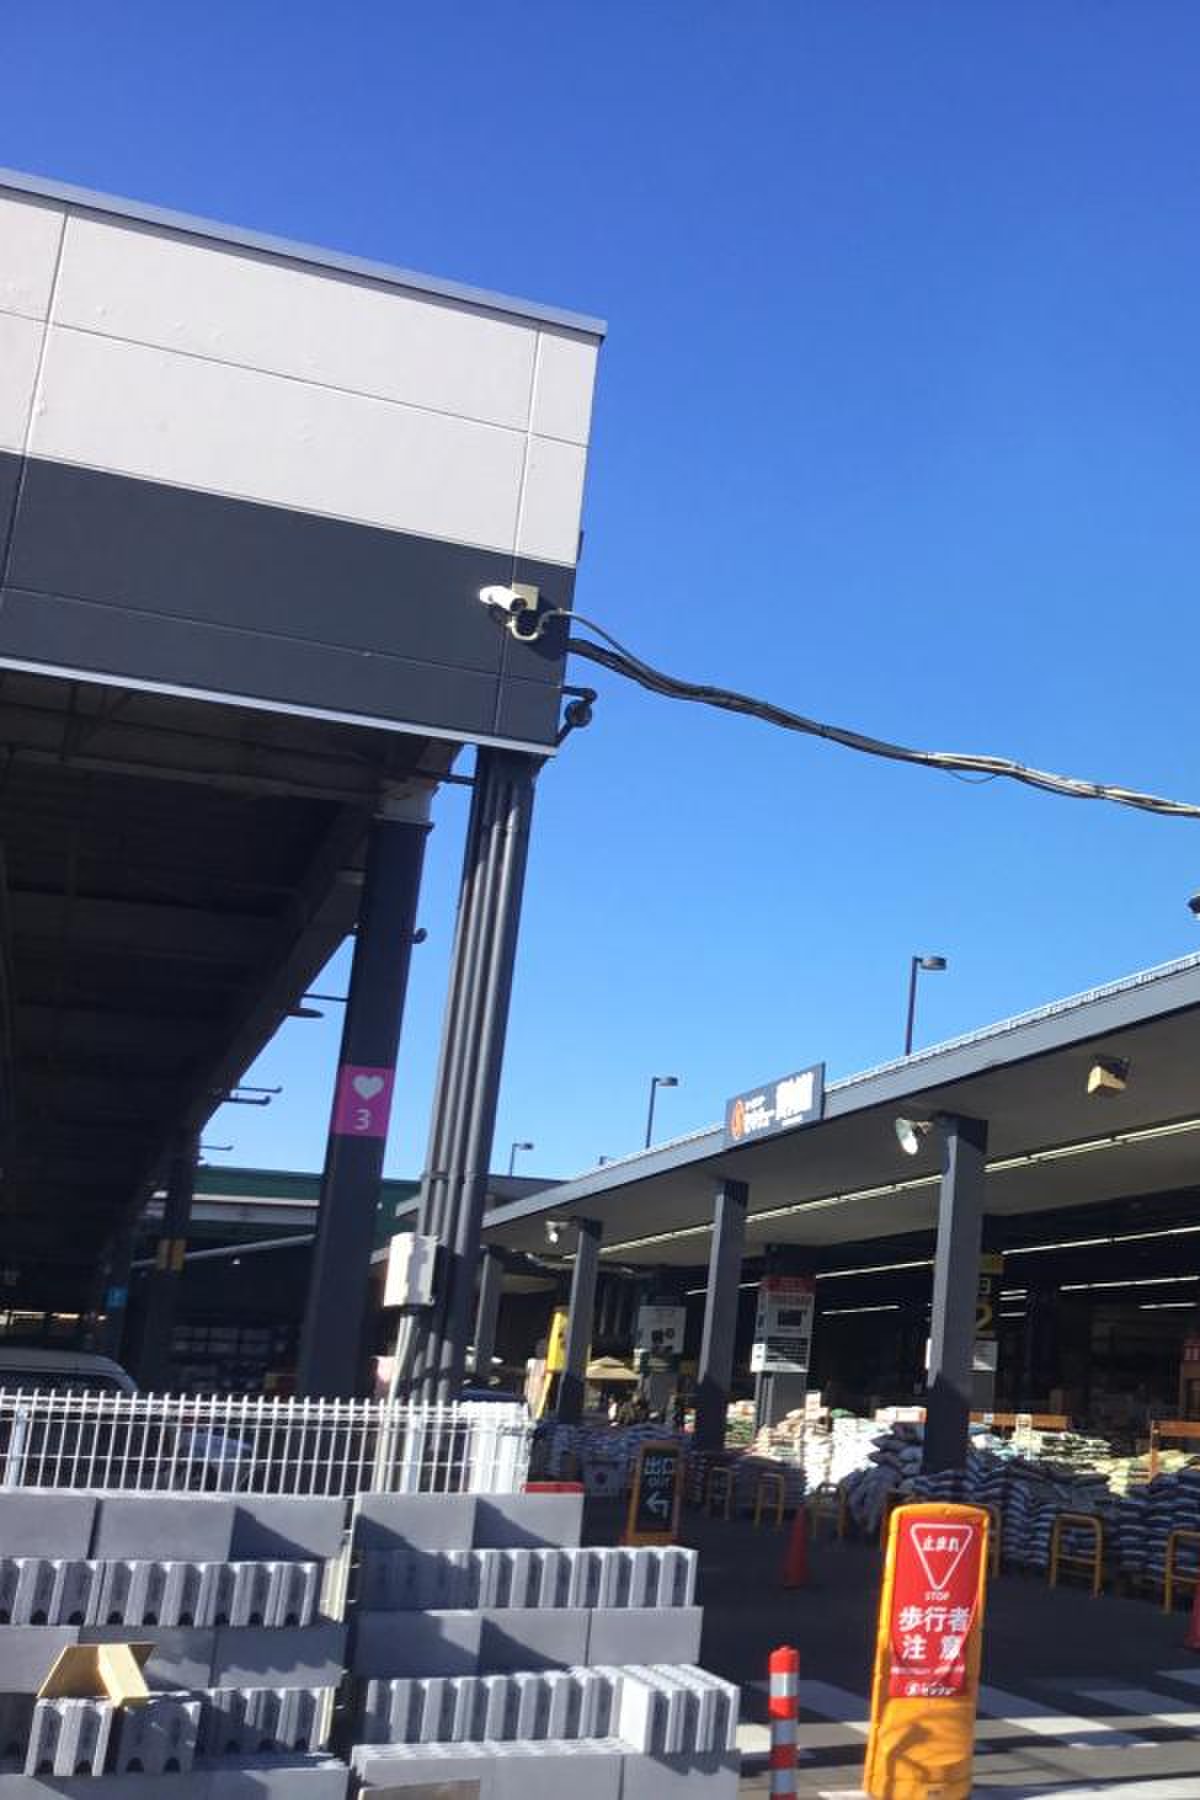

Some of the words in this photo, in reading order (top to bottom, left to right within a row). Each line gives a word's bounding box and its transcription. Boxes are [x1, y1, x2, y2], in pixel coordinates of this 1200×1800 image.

[354, 1109, 372, 1130] 3
[921, 1536, 960, 1552] 止まれ
[924, 1591, 951, 1601] STOP
[898, 1605, 970, 1633] 歩行者
